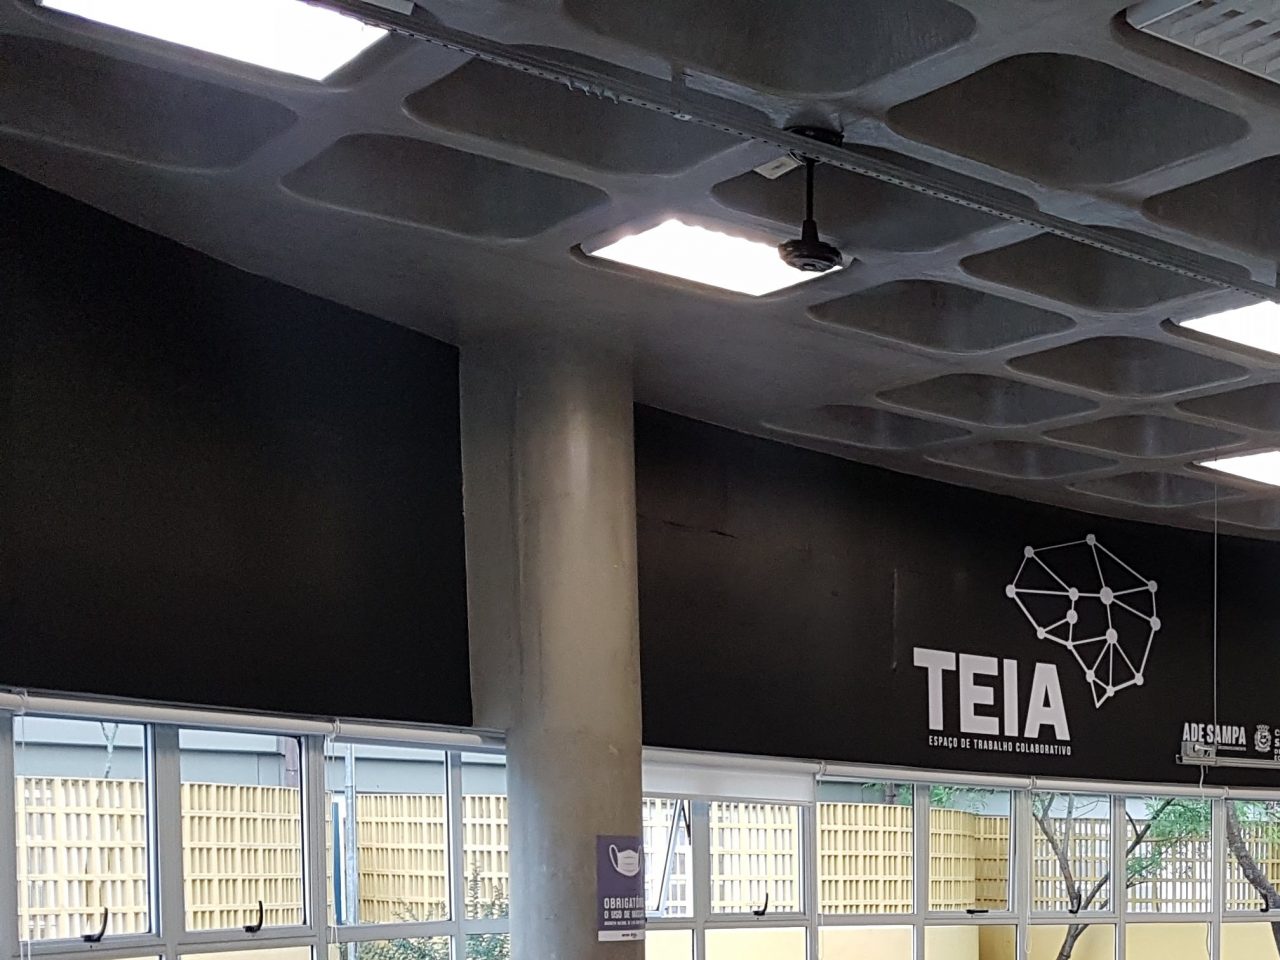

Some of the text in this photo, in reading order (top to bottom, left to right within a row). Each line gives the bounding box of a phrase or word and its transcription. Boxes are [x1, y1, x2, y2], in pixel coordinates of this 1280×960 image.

[913, 647, 1071, 741] TEIA
[1183, 722, 1247, 745] ADE SAMPA
[929, 736, 1071, 755] ESPAÇO DE TRABALHO COLABORATIVO
